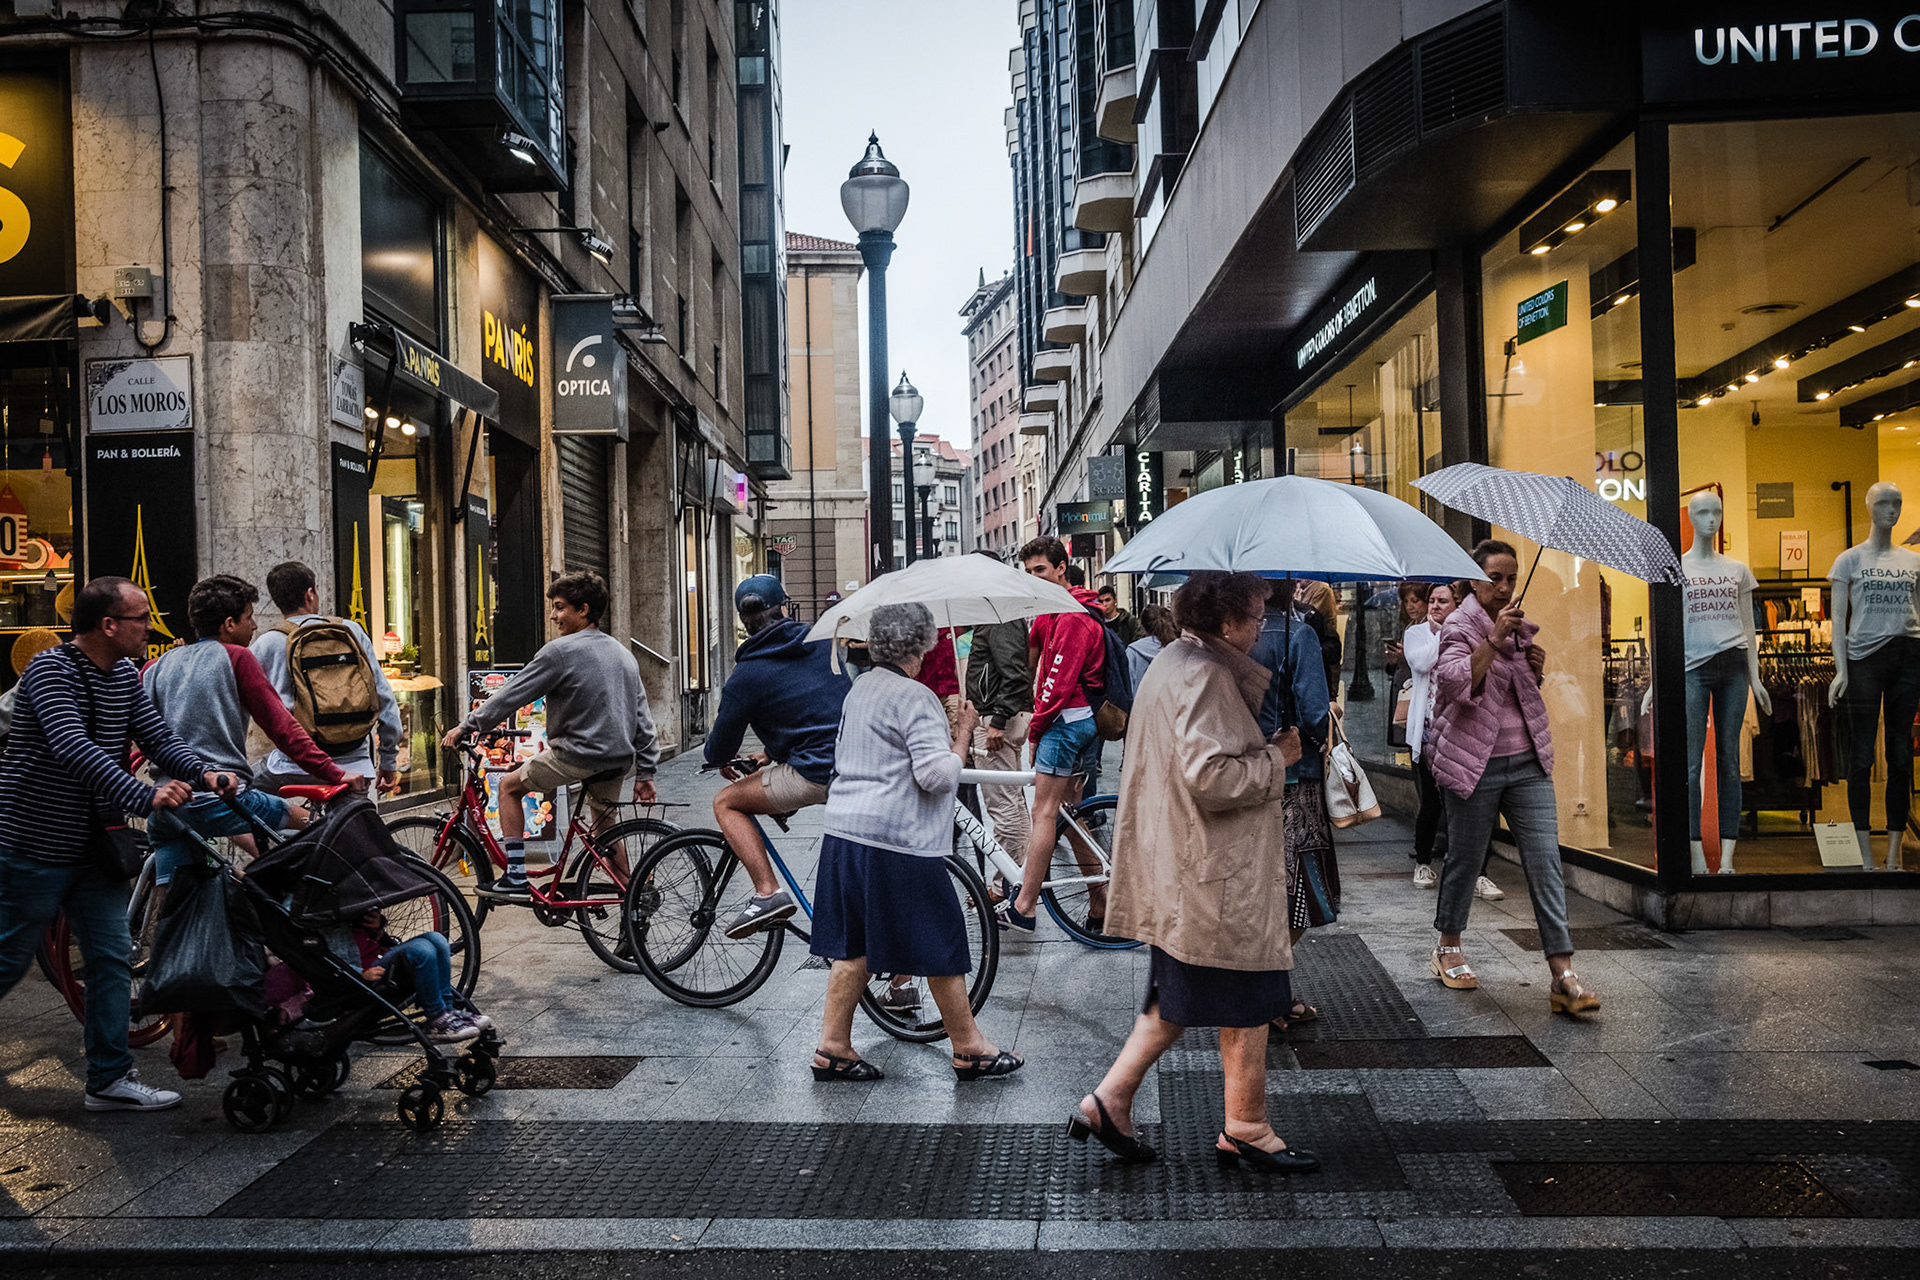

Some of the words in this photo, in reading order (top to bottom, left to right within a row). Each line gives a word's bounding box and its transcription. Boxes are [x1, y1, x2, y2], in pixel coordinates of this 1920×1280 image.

[1694, 19, 1879, 66] UNITED
[1535, 289, 1555, 308] COLORS
[1297, 338, 1315, 370] UNITED
[1314, 317, 1336, 354] COLORS
[1334, 308, 1344, 335] OF
[484, 310, 534, 388] PANRÍS
[127, 376, 156, 386] CALLE
[557, 379, 612, 397] OPTICA
[97, 393, 128, 416] LOS
[130, 390, 187, 414] MOROS
[97, 449, 119, 460] PAN
[120, 449, 129, 459] &
[131, 444, 181, 459] BOLLERÍA
[1137, 452, 1153, 522] CLARITA
[1685, 575, 1738, 587] REBAJAS
[1861, 568, 1916, 580] REBAJAS
[1686, 587, 1737, 601] REBAIXES
[1862, 580, 1915, 592] REBAIXES
[1687, 601, 1736, 614] REBAIXA
